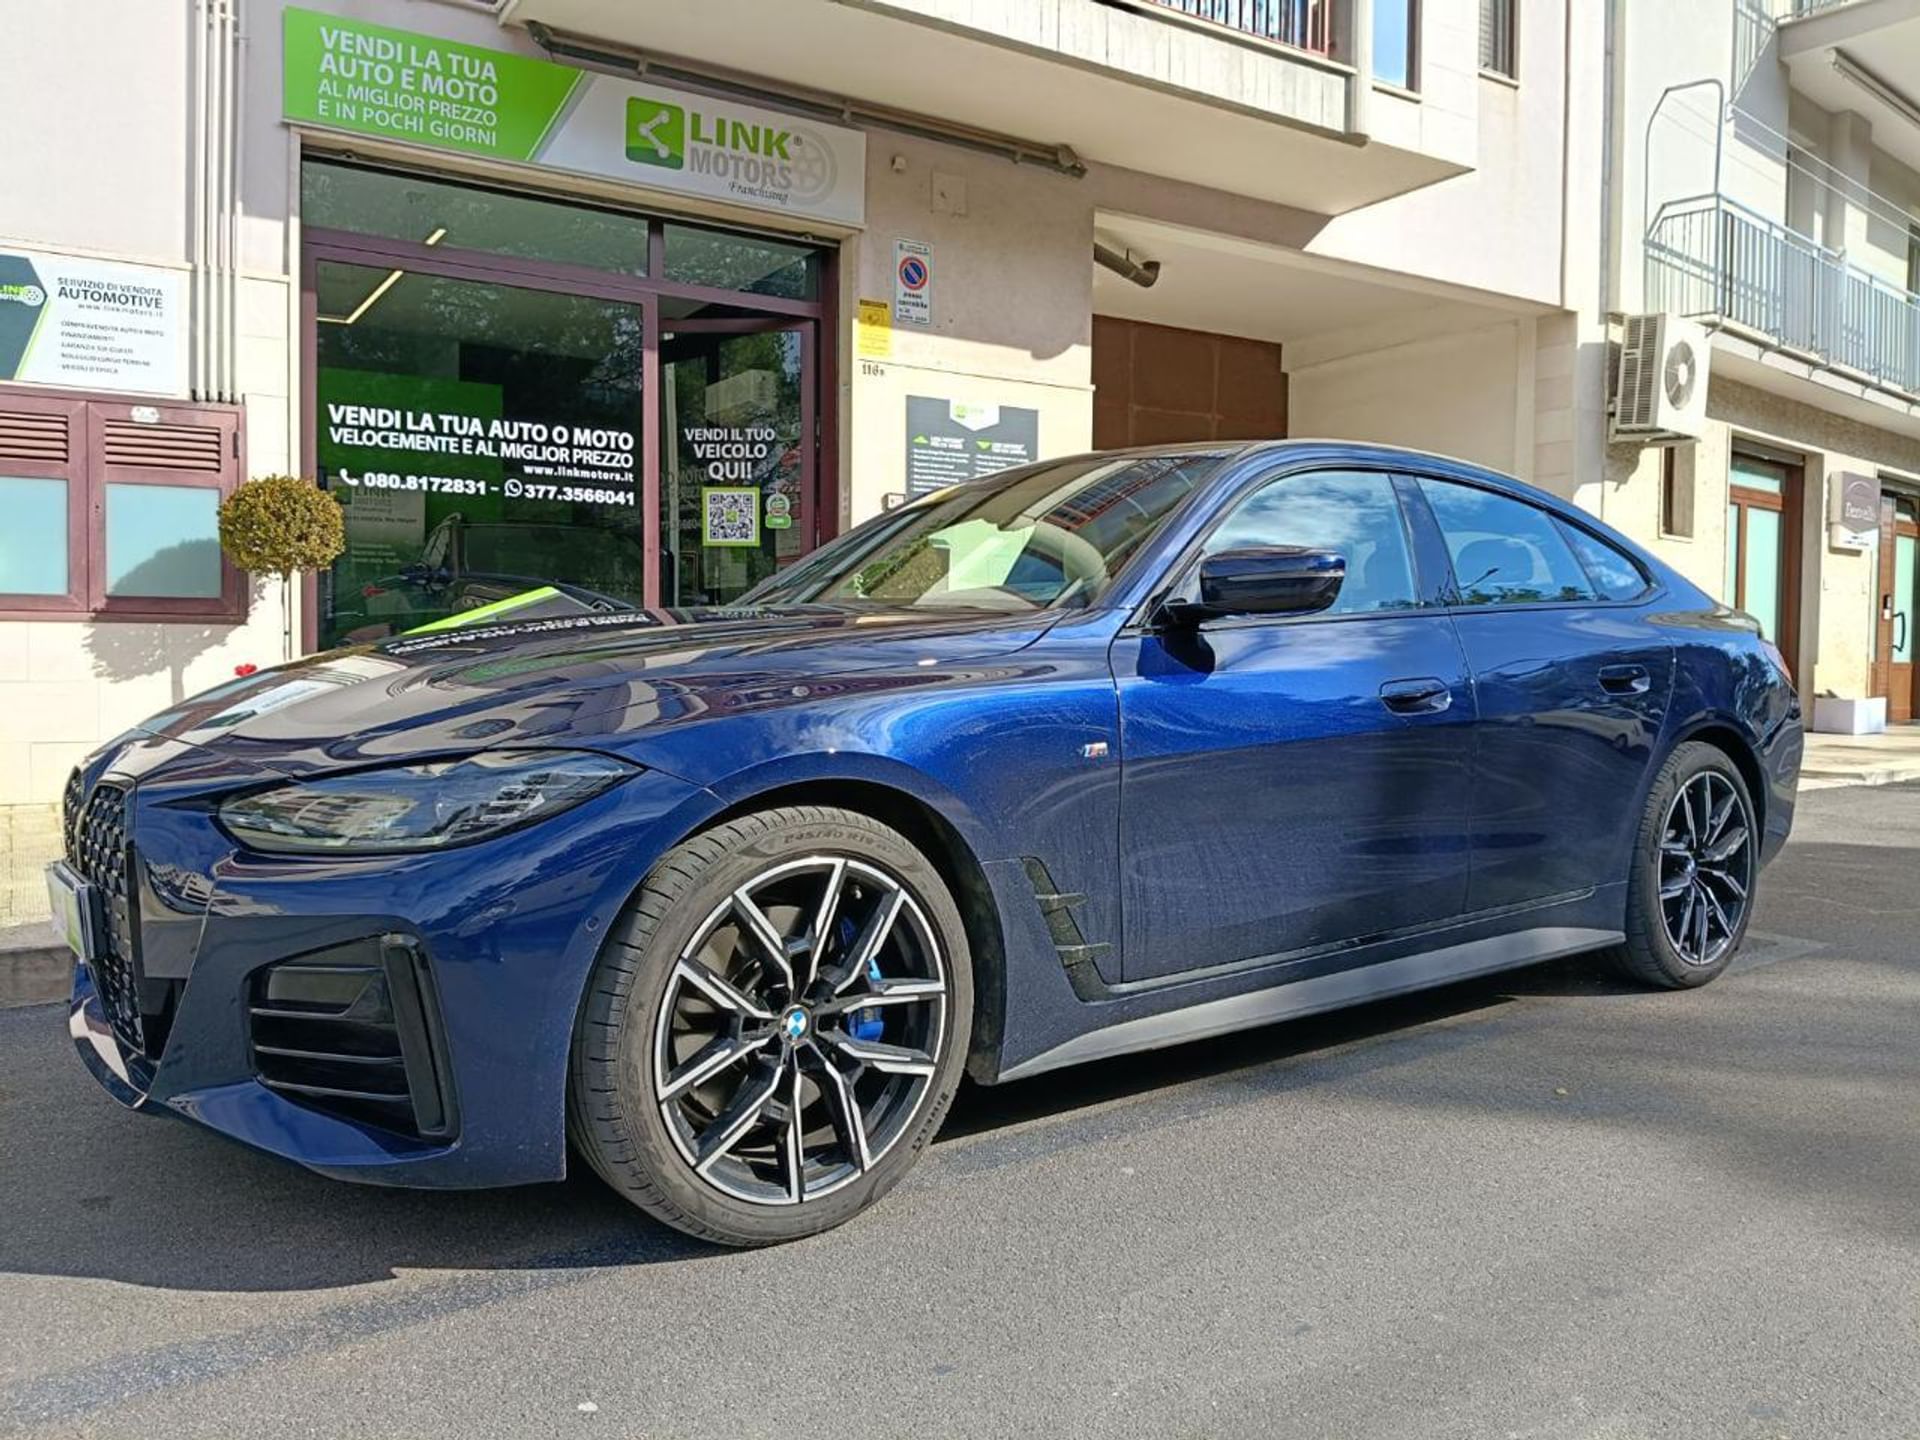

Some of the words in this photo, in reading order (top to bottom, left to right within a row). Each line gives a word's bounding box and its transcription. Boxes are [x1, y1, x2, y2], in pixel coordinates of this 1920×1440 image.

[319, 26, 402, 64] VENDI
[410, 47, 442, 72] LA
[447, 53, 498, 83] TUA
[319, 53, 394, 85] AUTO
[401, 68, 415, 91] E
[422, 72, 498, 107] MOTO
[318, 79, 342, 98] AL
[346, 83, 426, 115] MIGLIOR
[428, 100, 497, 127] PREZZO
[318, 100, 329, 116] E
[335, 103, 355, 122] IN
[362, 106, 424, 134] POCHI
[429, 120, 497, 148] GIORNI
[690, 113, 791, 161] LINK
[690, 147, 793, 190] MOTORS
[57, 276, 105, 290] SERVIZIO
[106, 283, 119, 292] DI
[119, 284, 164, 297] VENDITA
[57, 287, 164, 310] AUTOMOTIVE
[327, 403, 401, 430] VENDI
[406, 411, 436, 433] LA
[438, 414, 485, 438] TUA
[488, 419, 548, 443] AUTO
[552, 425, 569, 445] O
[572, 427, 635, 451] MOTO
[329, 427, 461, 454] VELOCEMENTE
[461, 438, 474, 455] E
[475, 439, 498, 458] AL
[499, 443, 571, 465] MIGLIOR
[572, 450, 635, 469] PREZZO
[684, 428, 728, 442] VENDI
[730, 428, 744, 441] IL
[744, 428, 777, 442] TUO
[693, 443, 768, 459] VEICOLO
[708, 461, 753, 481] QUI!
[363, 471, 487, 496] 080.8172831
[523, 483, 636, 507] 377.3566041
[523, 463, 635, 483] www.linkmotors.it
